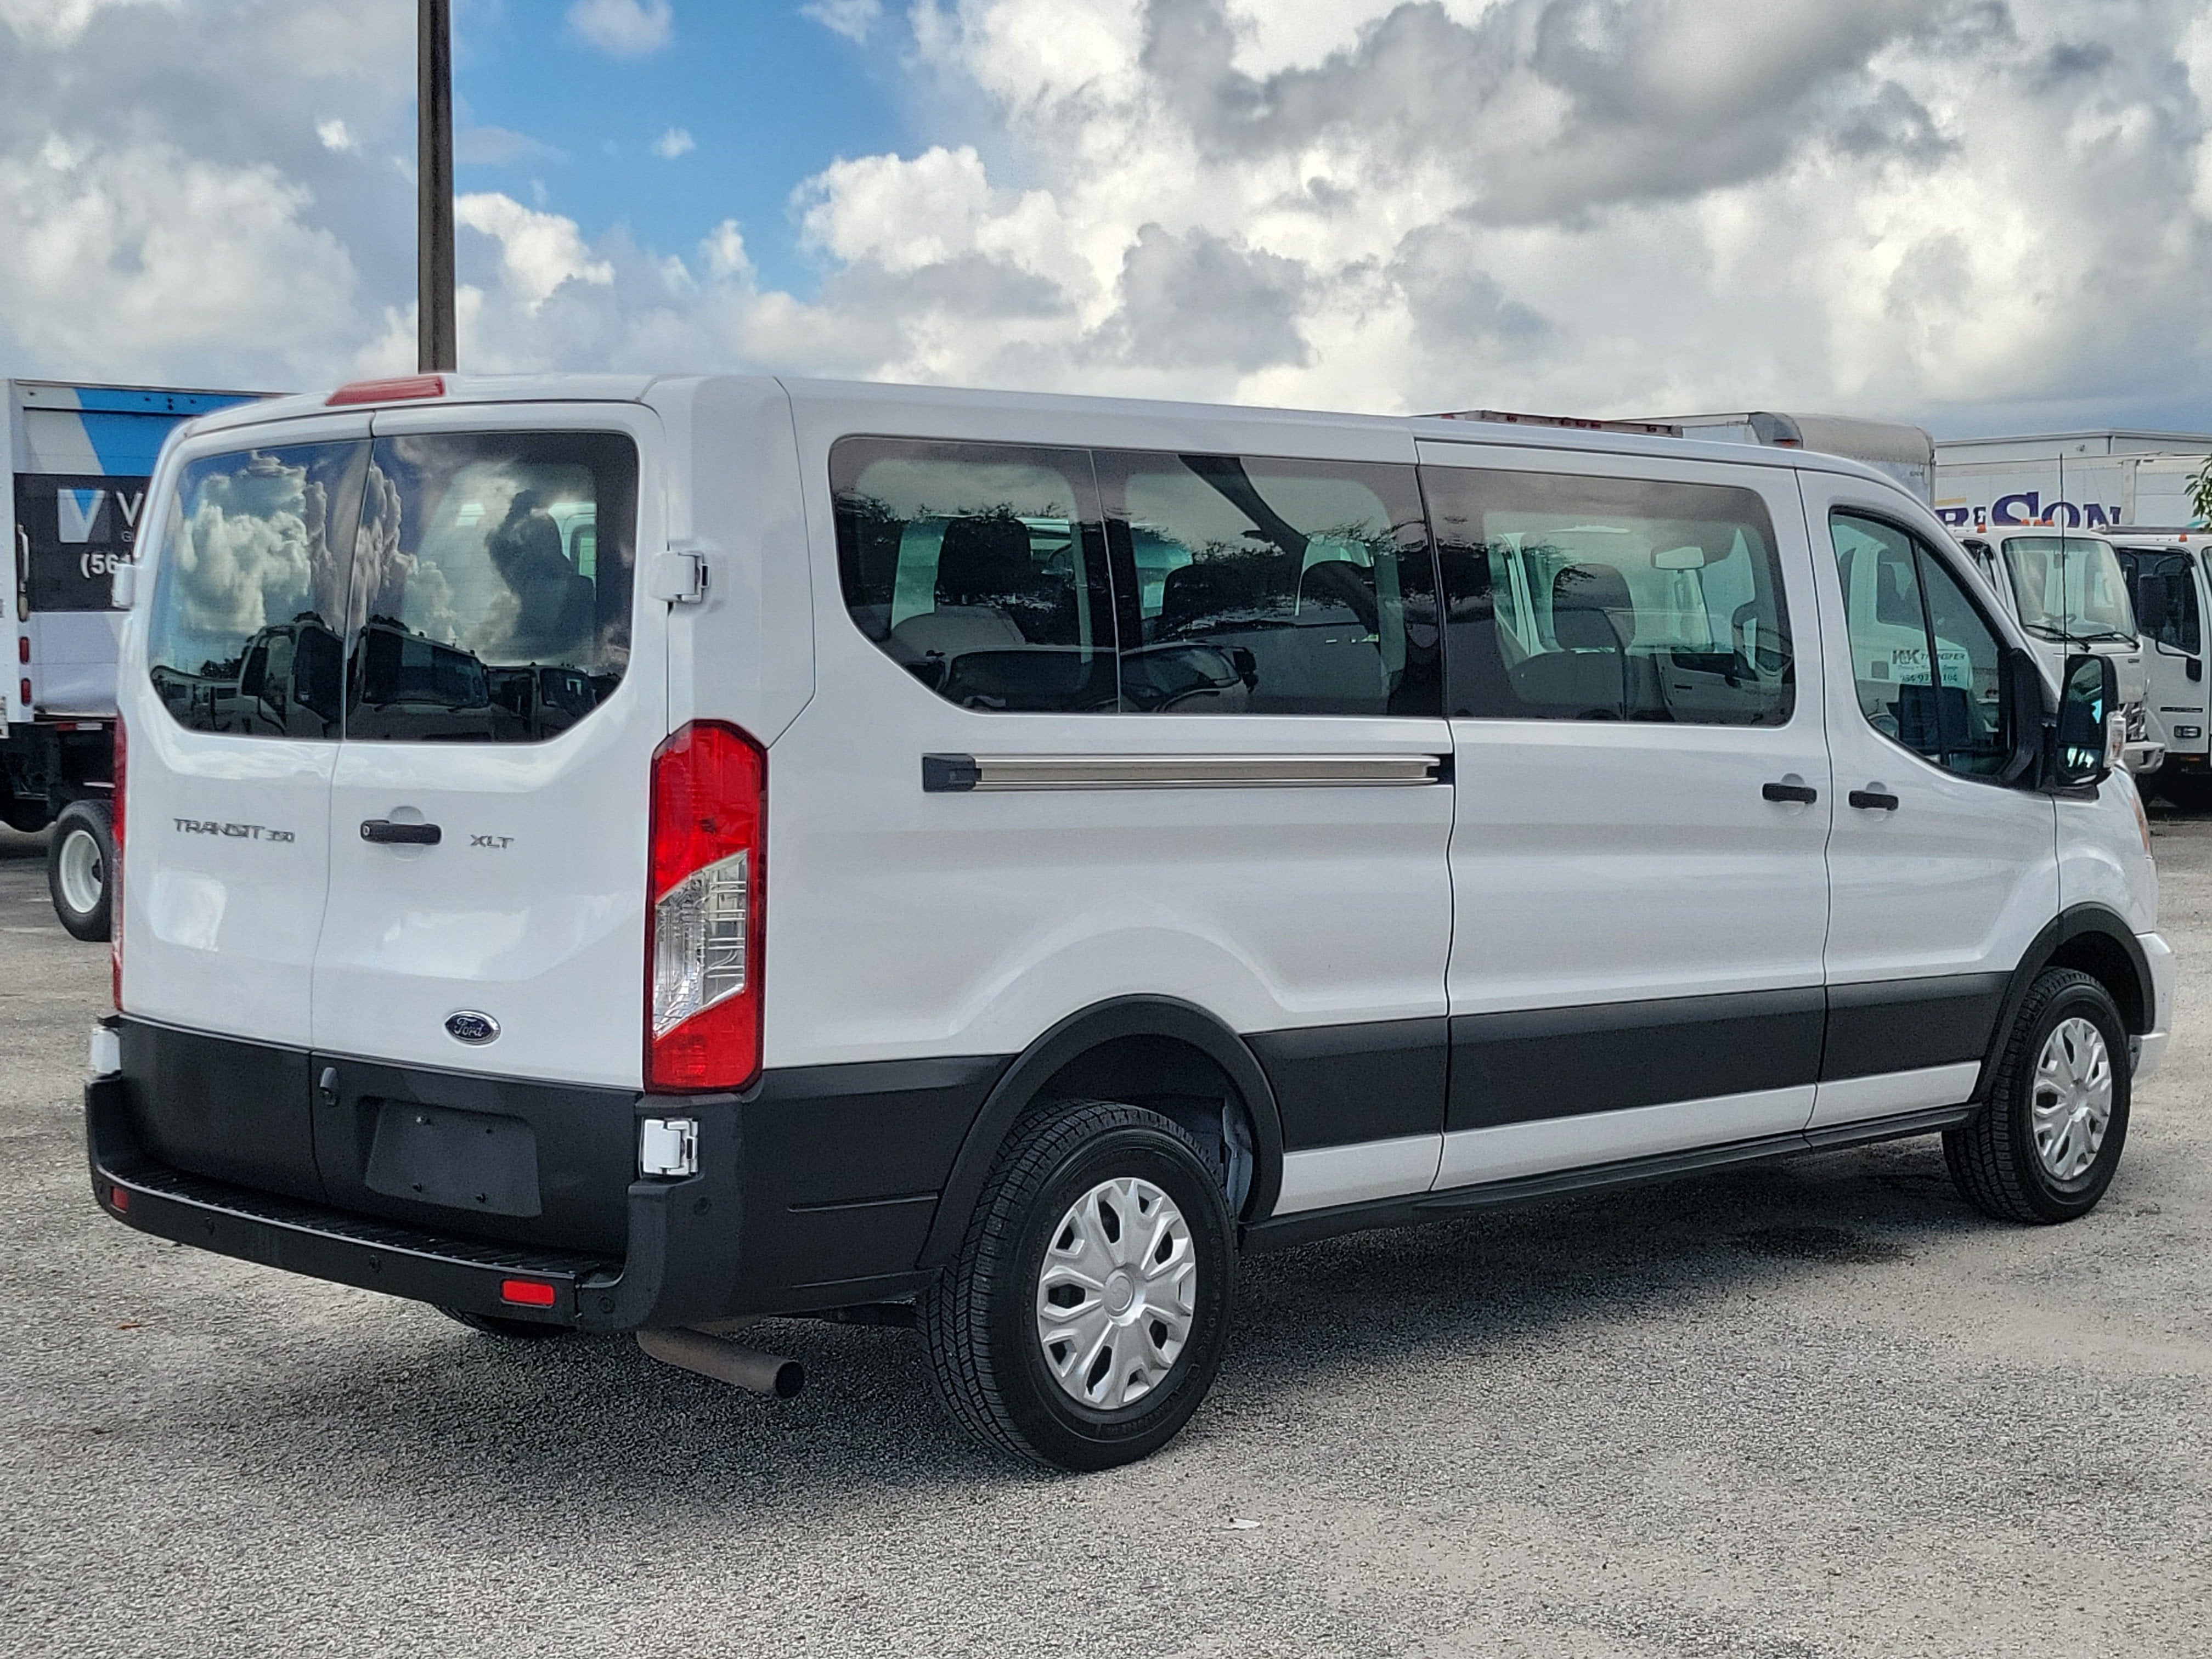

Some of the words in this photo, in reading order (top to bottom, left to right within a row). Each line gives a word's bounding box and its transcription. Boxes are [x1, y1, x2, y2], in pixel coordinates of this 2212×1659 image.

[173, 818, 265, 839] TRANSIT
[470, 834, 514, 849] XLT
[454, 1017, 484, 1037] Ford
